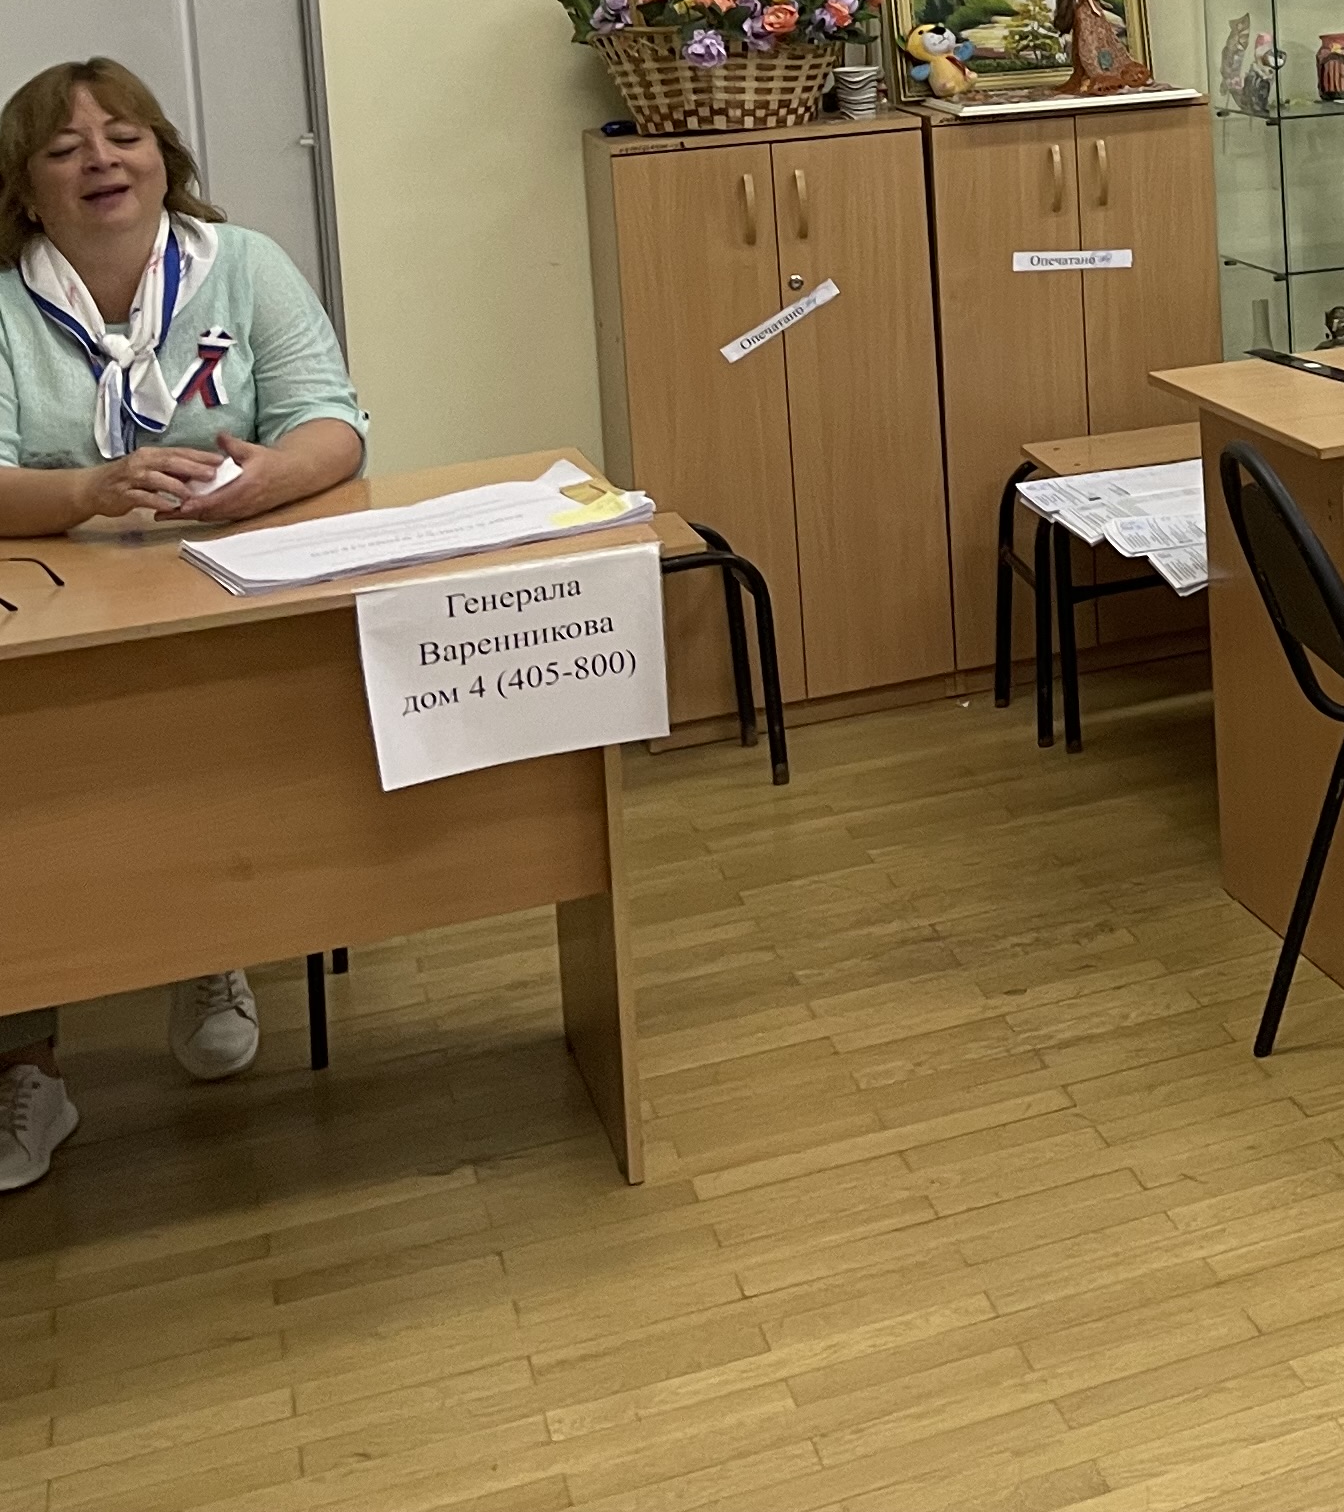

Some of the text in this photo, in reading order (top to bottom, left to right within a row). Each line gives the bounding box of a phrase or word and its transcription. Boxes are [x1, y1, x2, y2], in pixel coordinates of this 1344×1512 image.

[1030, 254, 1097, 267] Опечатано
[740, 306, 805, 350] Опечатано
[446, 579, 582, 619] Генерала
[419, 616, 615, 667] Варенникова
[401, 648, 637, 717] дом 4 (405-800)
